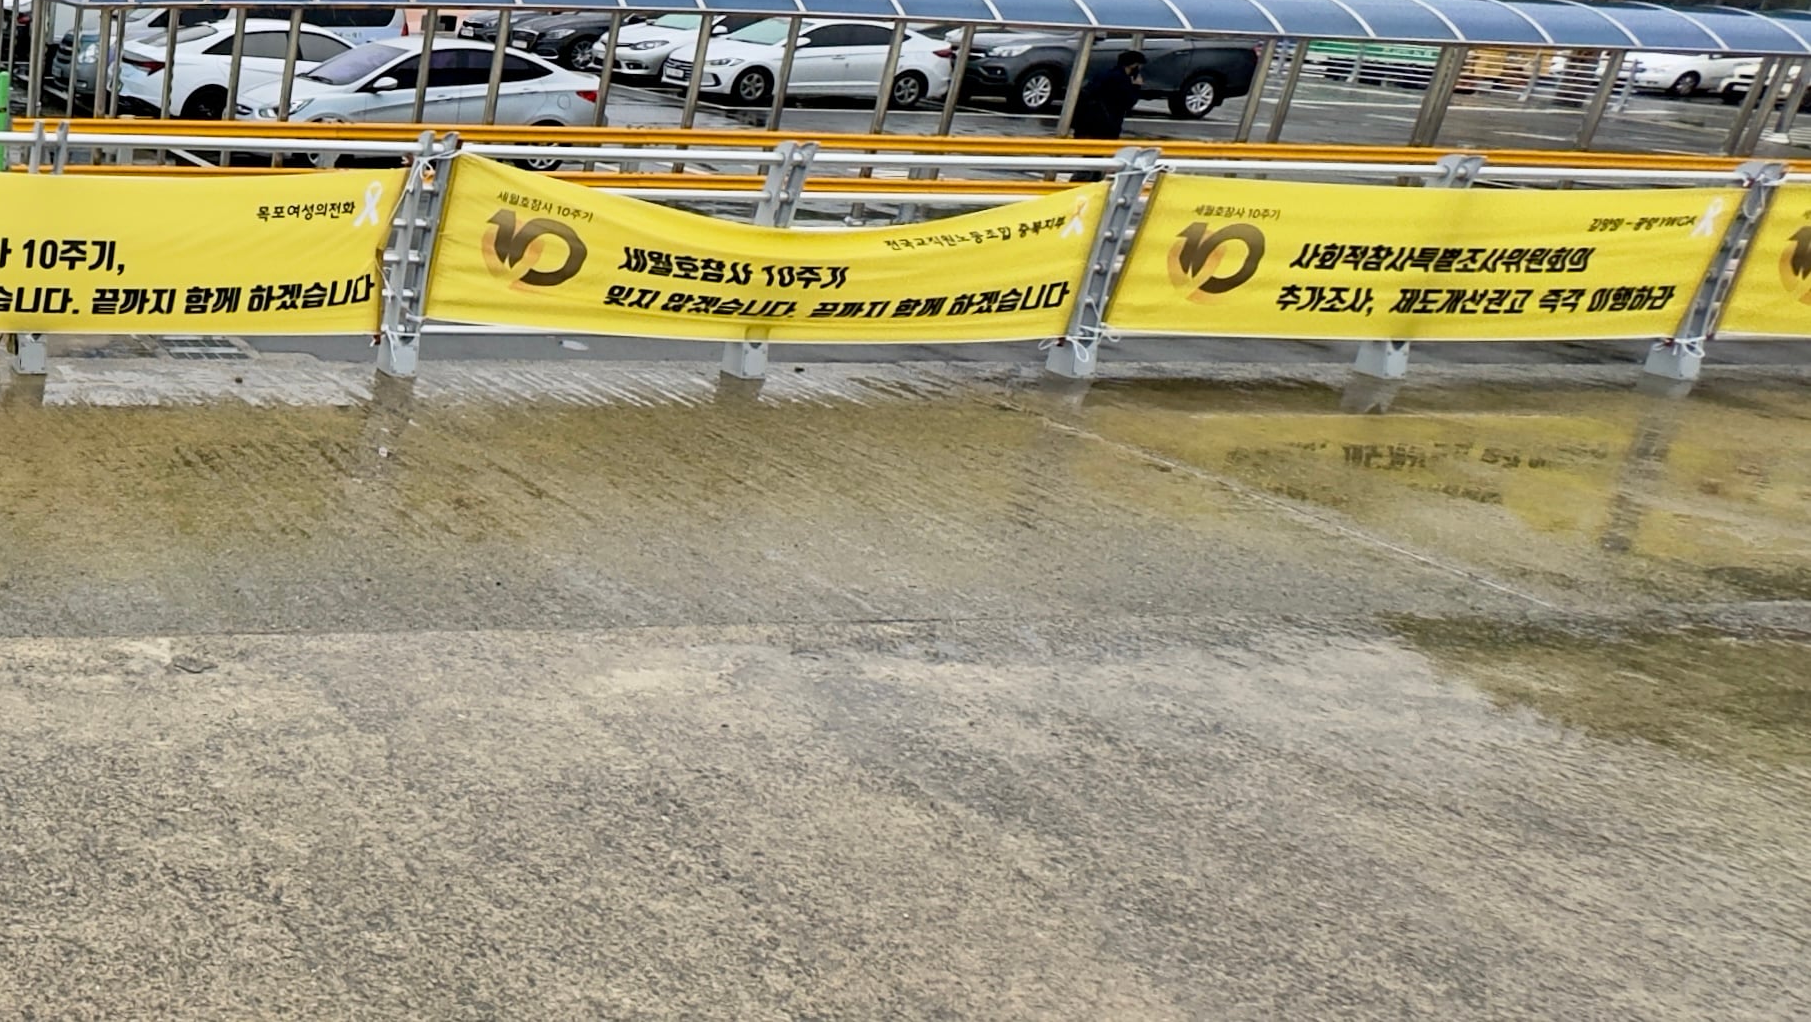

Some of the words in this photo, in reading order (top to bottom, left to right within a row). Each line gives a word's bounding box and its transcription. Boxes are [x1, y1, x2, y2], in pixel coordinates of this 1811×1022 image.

[256, 201, 356, 222] 목포여성의전화
[496, 191, 553, 214] 세월호참사
[556, 205, 594, 223] 10주기
[1247, 208, 1281, 221] 10주기
[22, 239, 125, 276] 10주기,
[618, 246, 754, 286] 세월호참사
[761, 265, 850, 290] 10주기
[1289, 242, 1596, 274] 사회적참사특별조사위원회의
[91, 288, 177, 315] 끝까지
[184, 286, 242, 315] 함께
[247, 273, 376, 313] 하겠습니다
[603, 284, 662, 310] 잊지
[807, 300, 891, 318] 끝까지
[891, 296, 949, 319] 함께
[946, 280, 1071, 317] 하겠습니다
[1276, 284, 1374, 317] 추가조사,
[1388, 288, 1535, 315] 제도개선권고
[1538, 288, 1587, 314] 즉각
[1586, 285, 1677, 313] 이행하라
